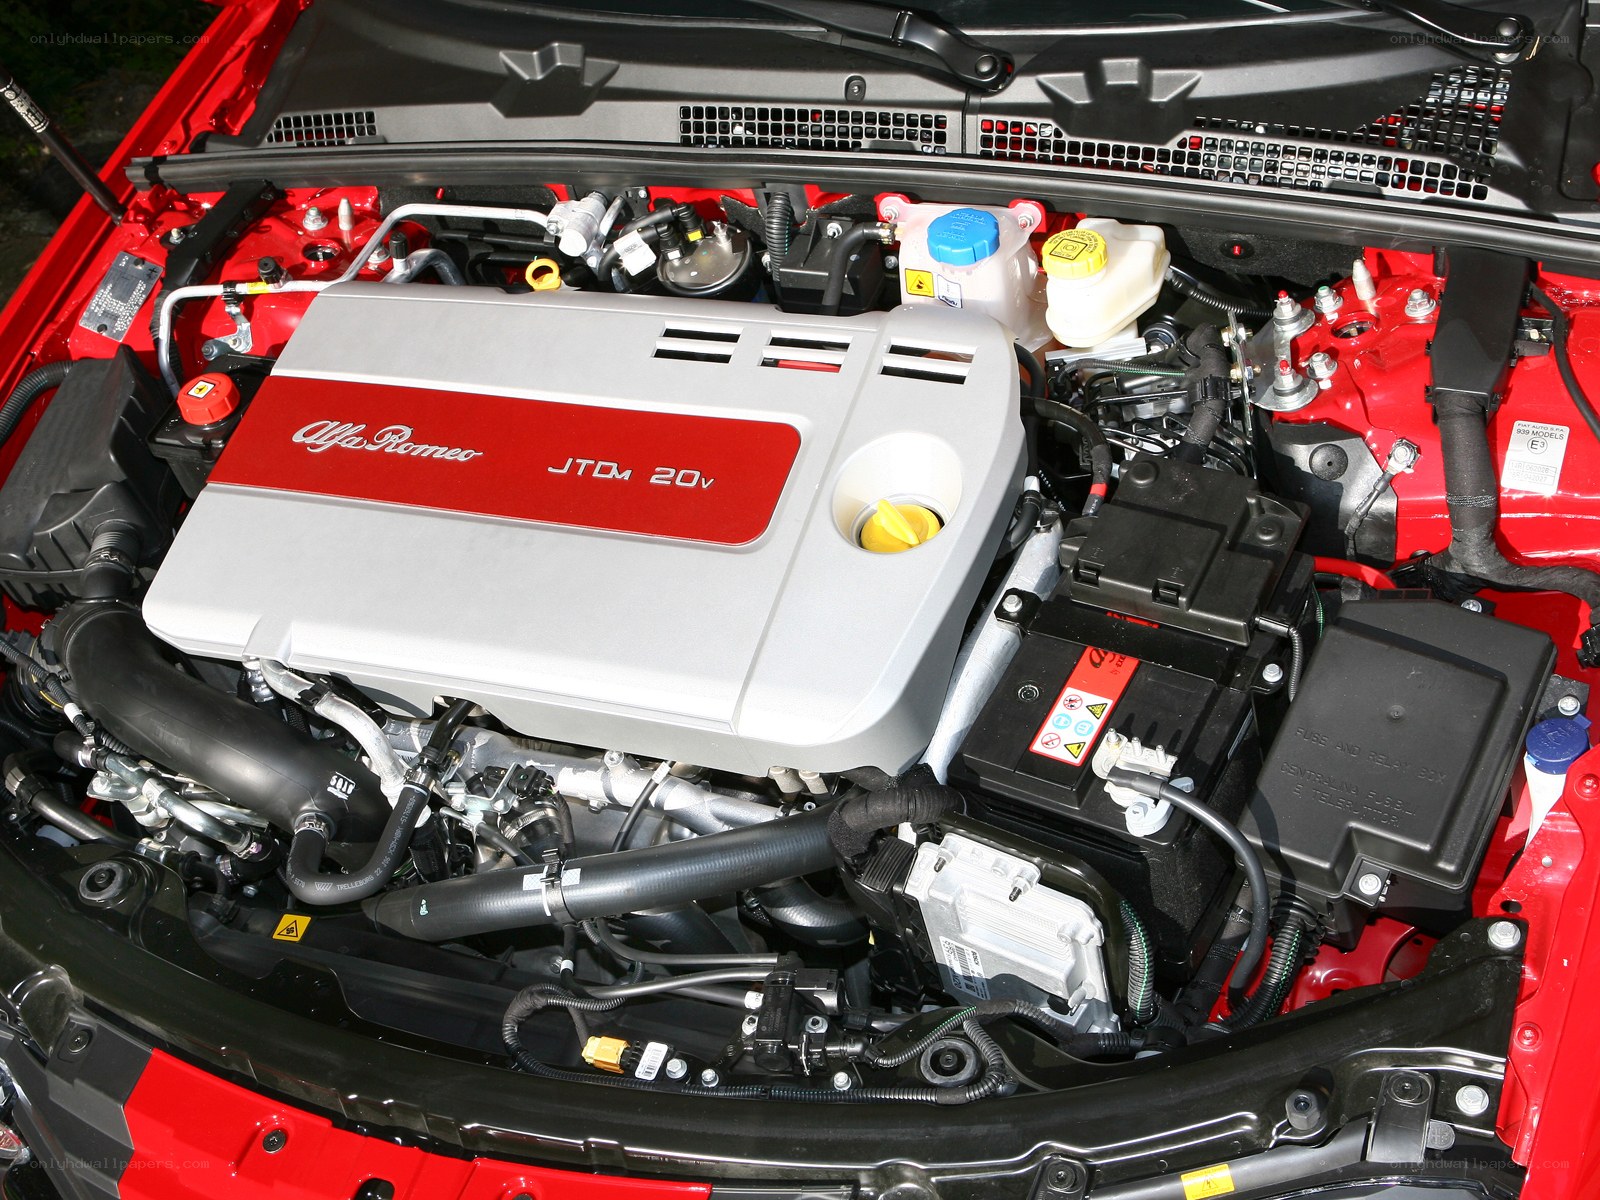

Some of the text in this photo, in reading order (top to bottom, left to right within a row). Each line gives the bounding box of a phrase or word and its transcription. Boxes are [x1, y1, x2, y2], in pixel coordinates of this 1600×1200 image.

[292, 420, 484, 462] Alfa Romeo
[1516, 428, 1565, 441] 939 MODELS
[1295, 726, 1330, 748] FUSE
[1335, 742, 1362, 758] AND
[1367, 751, 1412, 774] RELAY
[336, 874, 375, 891] TRELLEBORG
